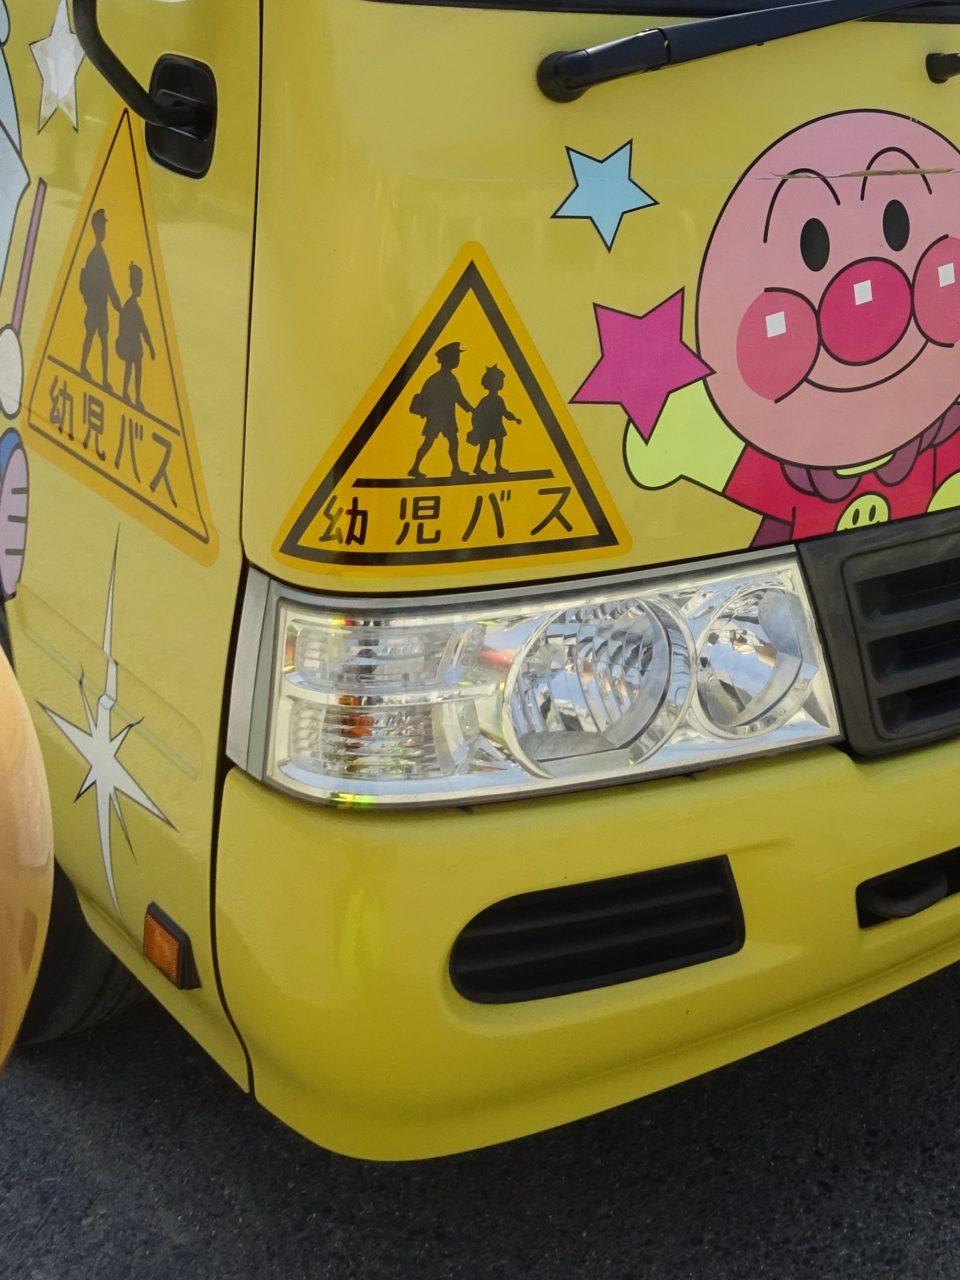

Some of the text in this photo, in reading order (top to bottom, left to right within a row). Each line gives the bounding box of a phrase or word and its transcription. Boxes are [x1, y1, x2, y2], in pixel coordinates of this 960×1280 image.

[49, 375, 178, 508] 幼児バス
[319, 486, 573, 546] 幼児バス
